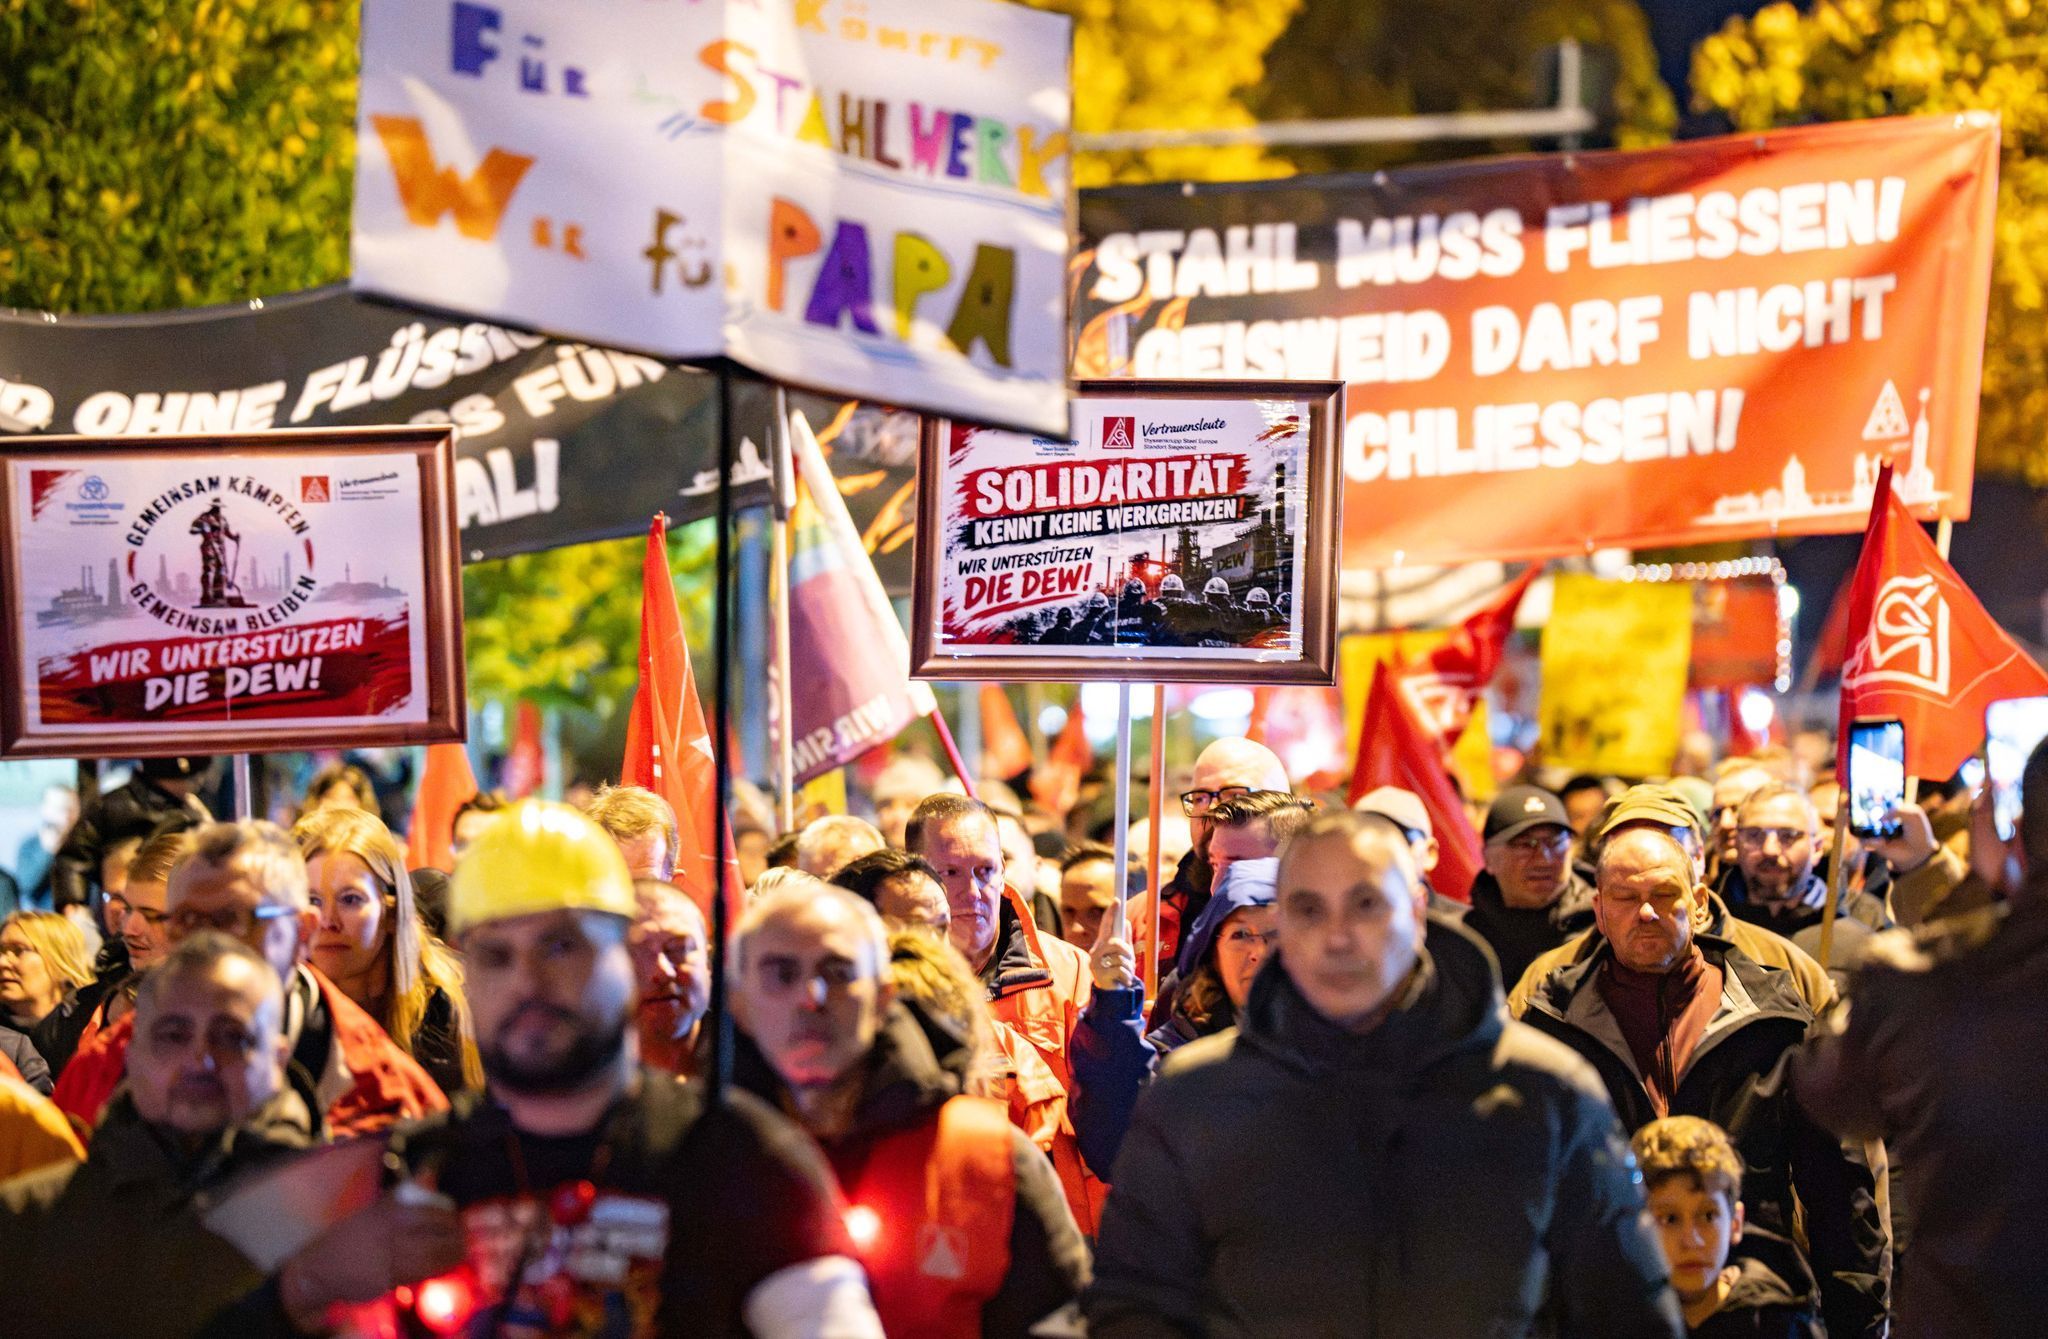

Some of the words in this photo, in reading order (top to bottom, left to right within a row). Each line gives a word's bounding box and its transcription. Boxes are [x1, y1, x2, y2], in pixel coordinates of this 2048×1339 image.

[698, 38, 1069, 198] STAHLWERK
[1095, 222, 1320, 303] STAHL
[1336, 207, 1525, 289] MUSS
[1545, 176, 1906, 272] FLIESSEN!
[766, 195, 1016, 369] PAPA
[1135, 308, 1451, 386] GEISWEID
[1471, 295, 1663, 377] DARF
[1688, 273, 1897, 359] NICHT
[72, 379, 287, 434] OHNE
[290, 322, 548, 424] FLÜSSI
[1142, 418, 1227, 437] Vertrauensleute
[1342, 387, 1745, 482] CHLIESSEN!
[126, 476, 220, 546] GEMEINSAM
[228, 475, 310, 536] KÄMPFEN
[456, 438, 560, 529] AL!
[975, 454, 1235, 514] SOLIDARITÄT
[974, 515, 1046, 546] KENNT
[1050, 510, 1102, 536] KEINE
[1106, 497, 1245, 530] WERKGRENZEN!
[958, 554, 991, 576] WIR
[992, 546, 1093, 571] UNTERSTÜTZEN
[964, 571, 1012, 610] DIE
[1021, 562, 1093, 598] DEW!
[1216, 551, 1246, 571] DEW
[130, 582, 238, 635] GEMEINSAM
[246, 575, 316, 630] BLEIBEN
[90, 648, 151, 682] WIR
[160, 621, 365, 672] UNTERSTÜTZEN
[145, 671, 209, 711] DIE
[224, 657, 323, 699] DEW!
